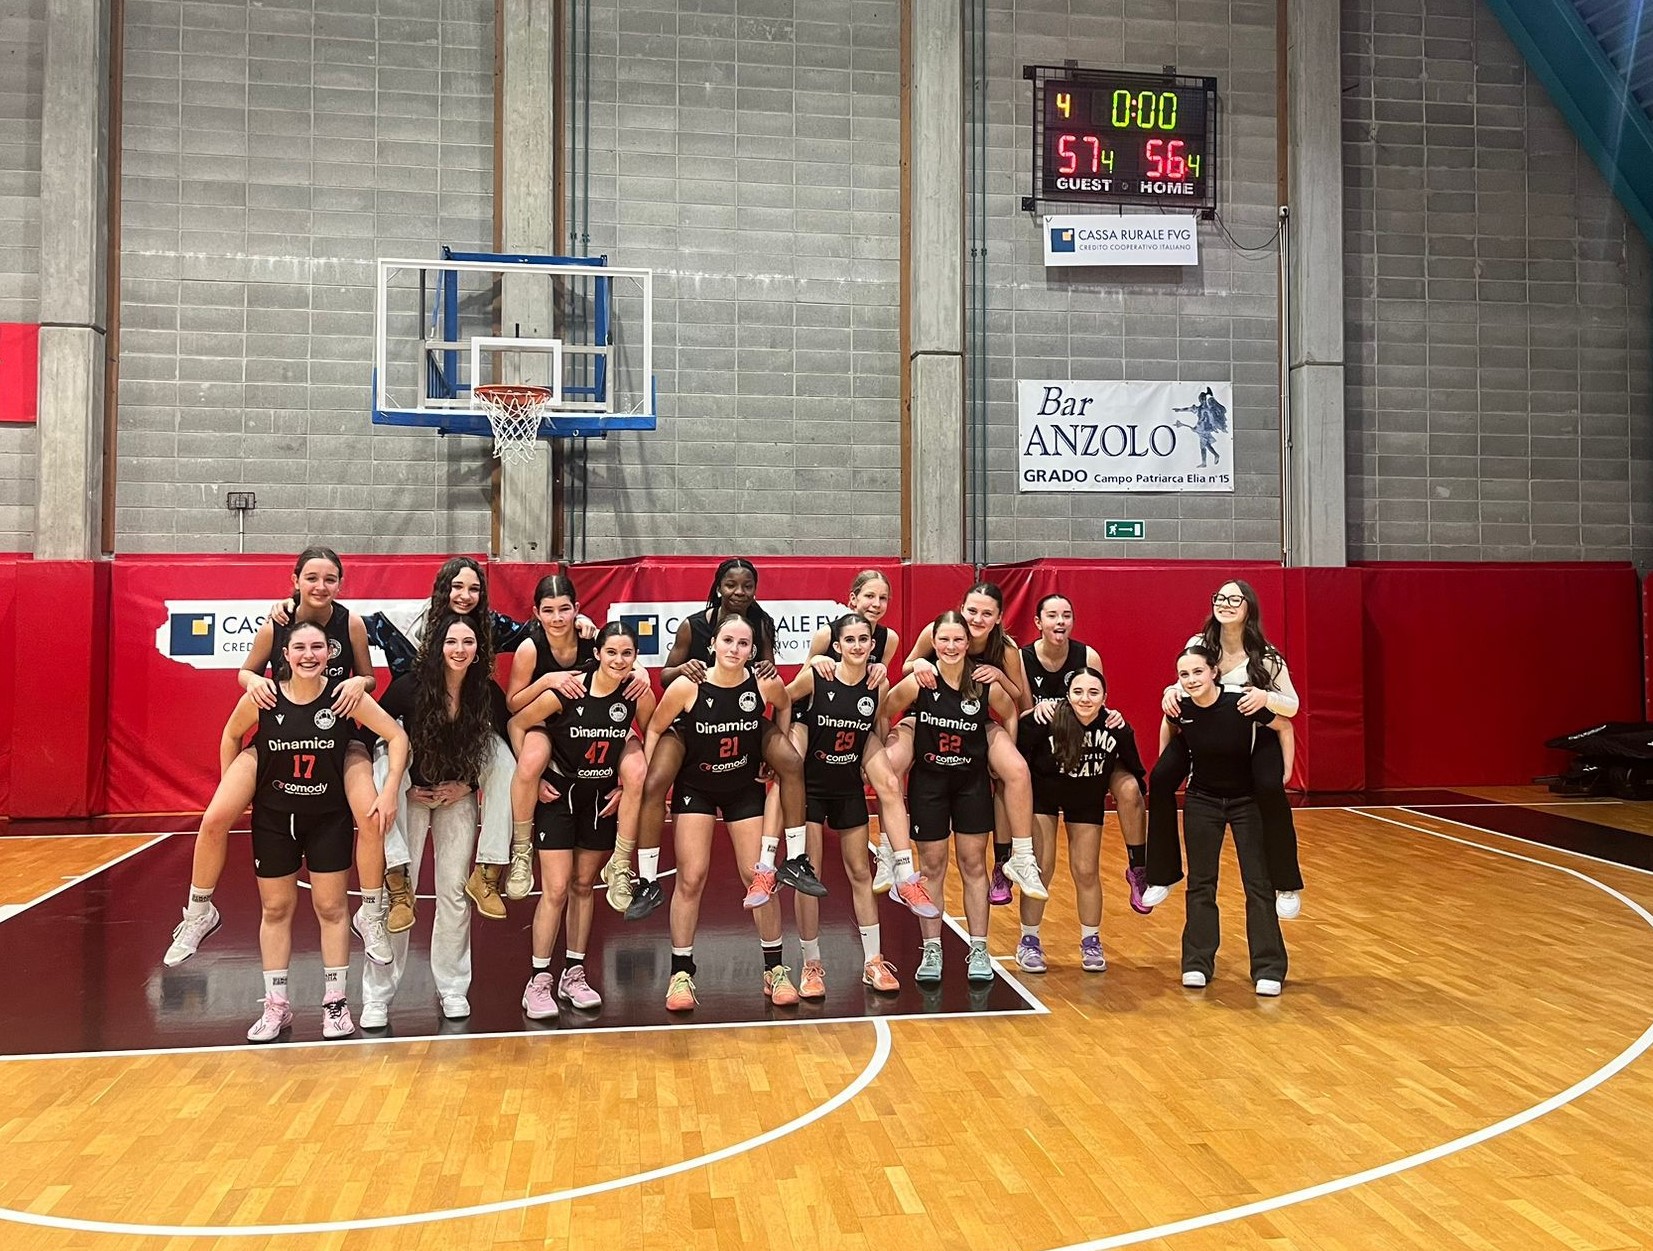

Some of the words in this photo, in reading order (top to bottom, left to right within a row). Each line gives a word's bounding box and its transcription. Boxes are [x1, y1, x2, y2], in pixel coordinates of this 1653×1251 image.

[1056, 93, 1071, 118] 4
[1111, 89, 1177, 130] 0:00
[1058, 135, 1100, 175] 57
[1101, 150, 1115, 174] 4
[1146, 139, 1185, 179] 56
[1187, 154, 1201, 178] 4
[1056, 177, 1112, 192] GUEST
[1140, 180, 1194, 195] HOME
[1078, 229, 1120, 241] CASSA
[1121, 229, 1165, 241] RURALE
[1167, 229, 1191, 241] FVG
[1037, 386, 1094, 416] Bar
[1023, 424, 1177, 457] ANZOLO
[1023, 469, 1088, 483] GRADO
[1094, 474, 1133, 485] Campo
[1136, 474, 1184, 483] Patriarca
[1187, 473, 1206, 483] Elia
[222, 616, 266, 634] CAS
[696, 719, 758, 734] Dinamica
[817, 714, 872, 731] Dinamica
[919, 711, 978, 731] Dinamica
[569, 725, 627, 739] Dinamica
[834, 731, 855, 751] 29
[268, 737, 335, 751] Dinamica
[585, 740, 610, 764] 47
[719, 736, 738, 757] 21
[938, 732, 962, 754] 22
[292, 754, 316, 779] 17
